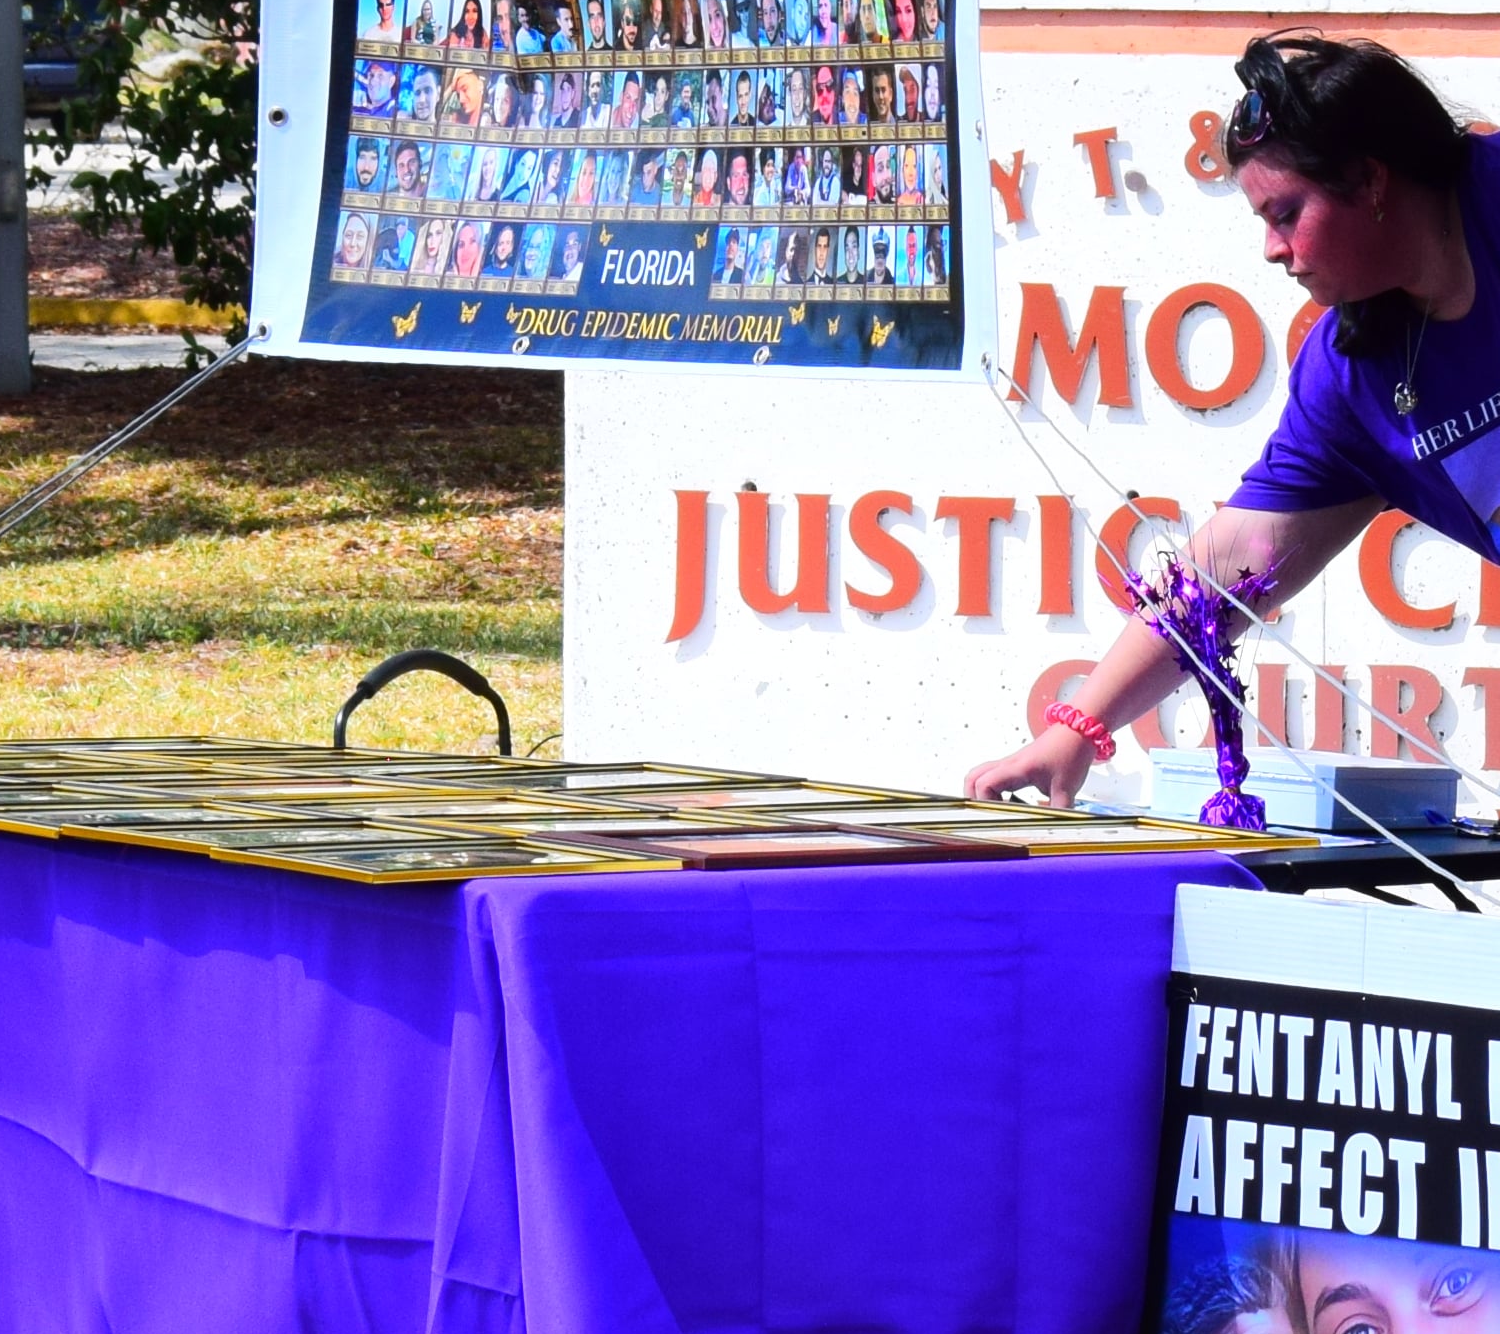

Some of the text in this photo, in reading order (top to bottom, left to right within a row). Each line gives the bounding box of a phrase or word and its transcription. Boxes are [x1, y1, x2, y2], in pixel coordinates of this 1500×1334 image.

[600, 248, 695, 287] FLORIDA
[515, 308, 784, 344] DRUG EPIDEMIC MEMORIAL
[1411, 418, 1465, 461] HER
[665, 489, 1280, 645] JUSTIC
[1180, 1003, 1462, 1121] FENTANYL
[1174, 1114, 1426, 1241] AFFECT
